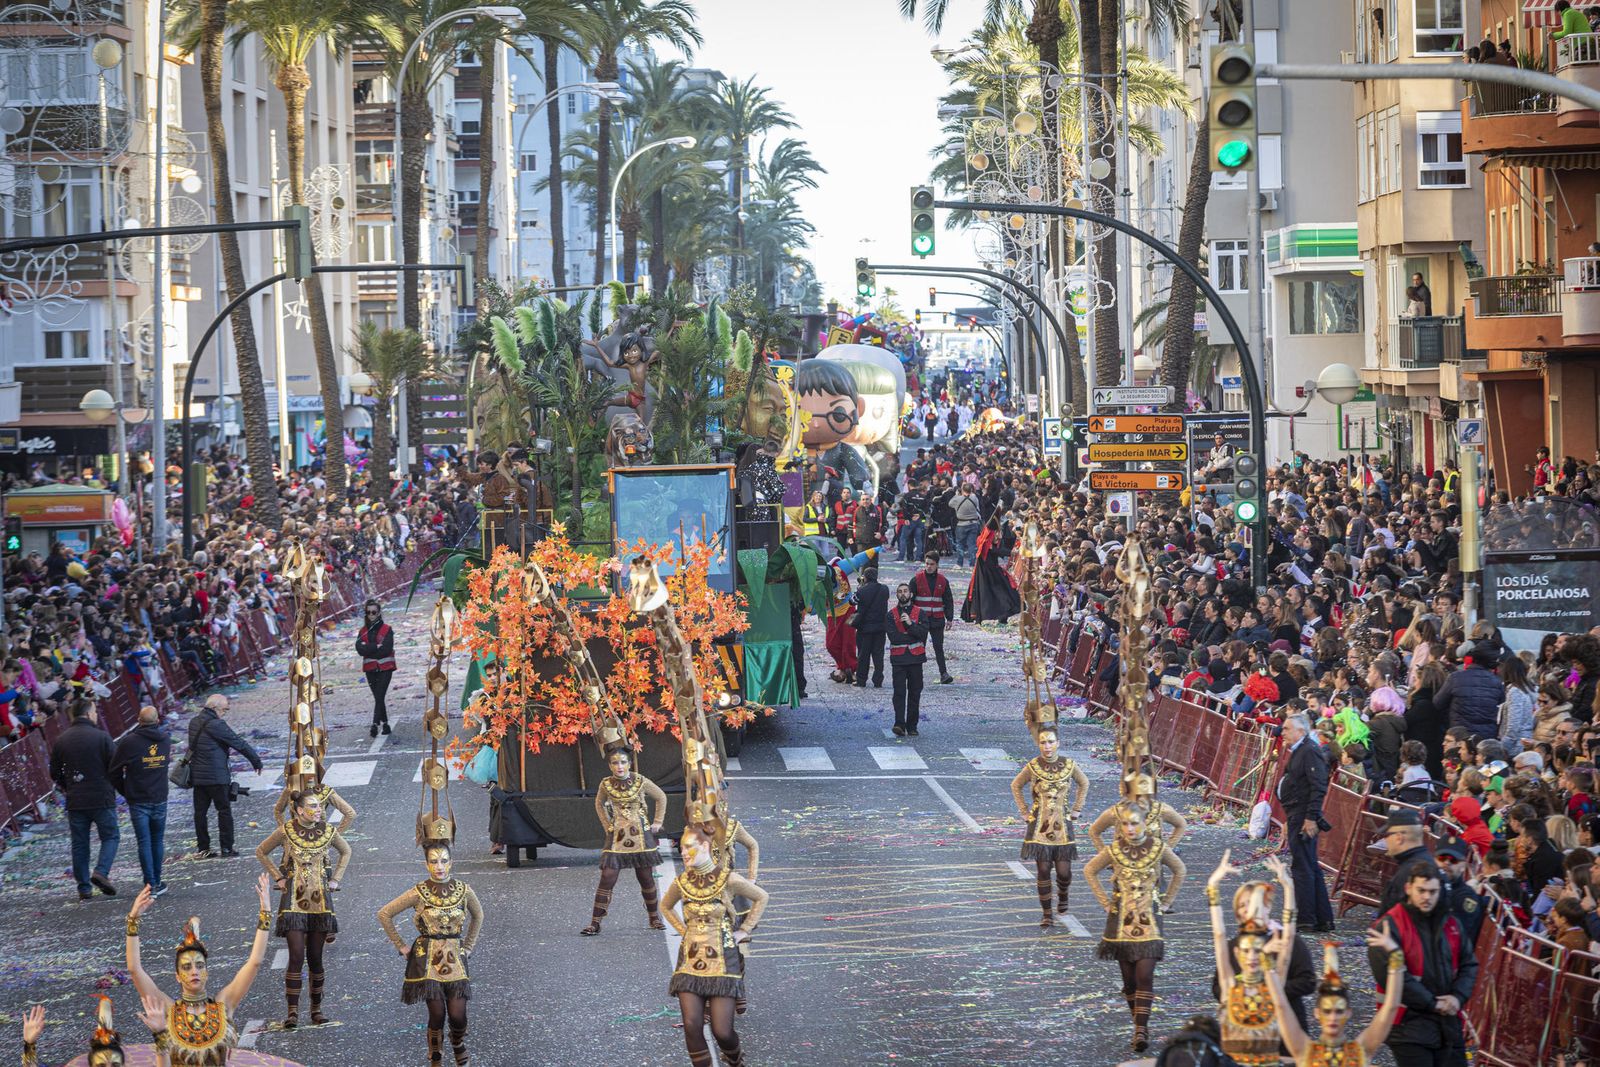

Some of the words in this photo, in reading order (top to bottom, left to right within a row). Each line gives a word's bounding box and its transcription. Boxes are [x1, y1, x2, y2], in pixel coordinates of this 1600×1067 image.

[1094, 449, 1144, 458] Hospedería
[1497, 576, 1518, 587] LOS
[1521, 574, 1549, 586] DÍAS
[1497, 588, 1590, 600] PORCELANOSA
